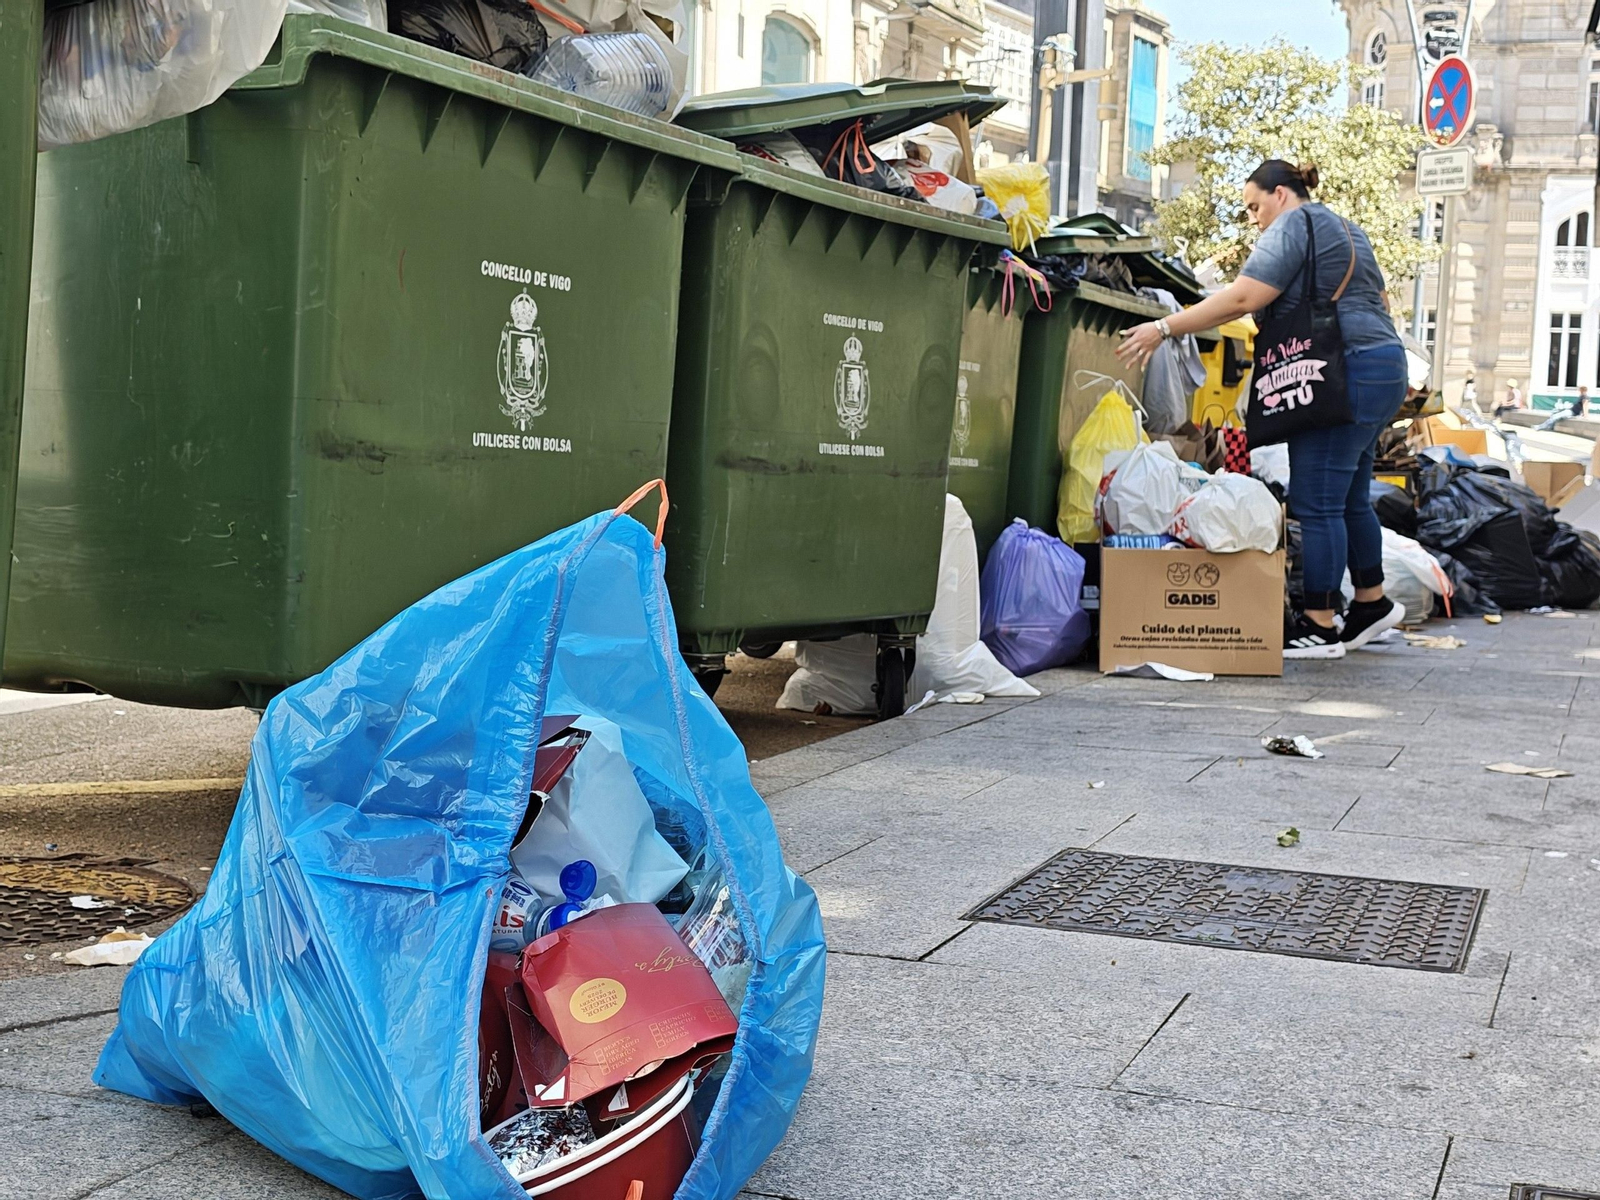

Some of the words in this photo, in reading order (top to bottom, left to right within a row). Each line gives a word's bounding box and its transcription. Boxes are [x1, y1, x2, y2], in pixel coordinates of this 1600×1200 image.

[481, 260, 531, 283] CONCELLO
[534, 271, 547, 287] DE
[549, 274, 571, 291] VIGO
[823, 313, 856, 327] CONCELLO
[858, 318, 867, 330] DE
[867, 320, 884, 332] VIGO
[473, 432, 520, 449] UTILICESE
[522, 436, 541, 450] CON
[543, 437, 572, 452] BOLSA
[819, 443, 850, 455] UTILICESE
[851, 445, 865, 456] CON
[865, 446, 884, 457] BOLSA
[1168, 593, 1216, 605] GADIS
[1142, 623, 1175, 634] Cuido
[1177, 625, 1195, 634] del
[1198, 625, 1241, 636] planeta
[493, 905, 525, 928] is
[660, 1016, 696, 1032] CAPRICHO
[606, 1048, 619, 1058] DRY
[620, 1039, 640, 1051] AGED
[612, 1056, 633, 1070] TEXAS
